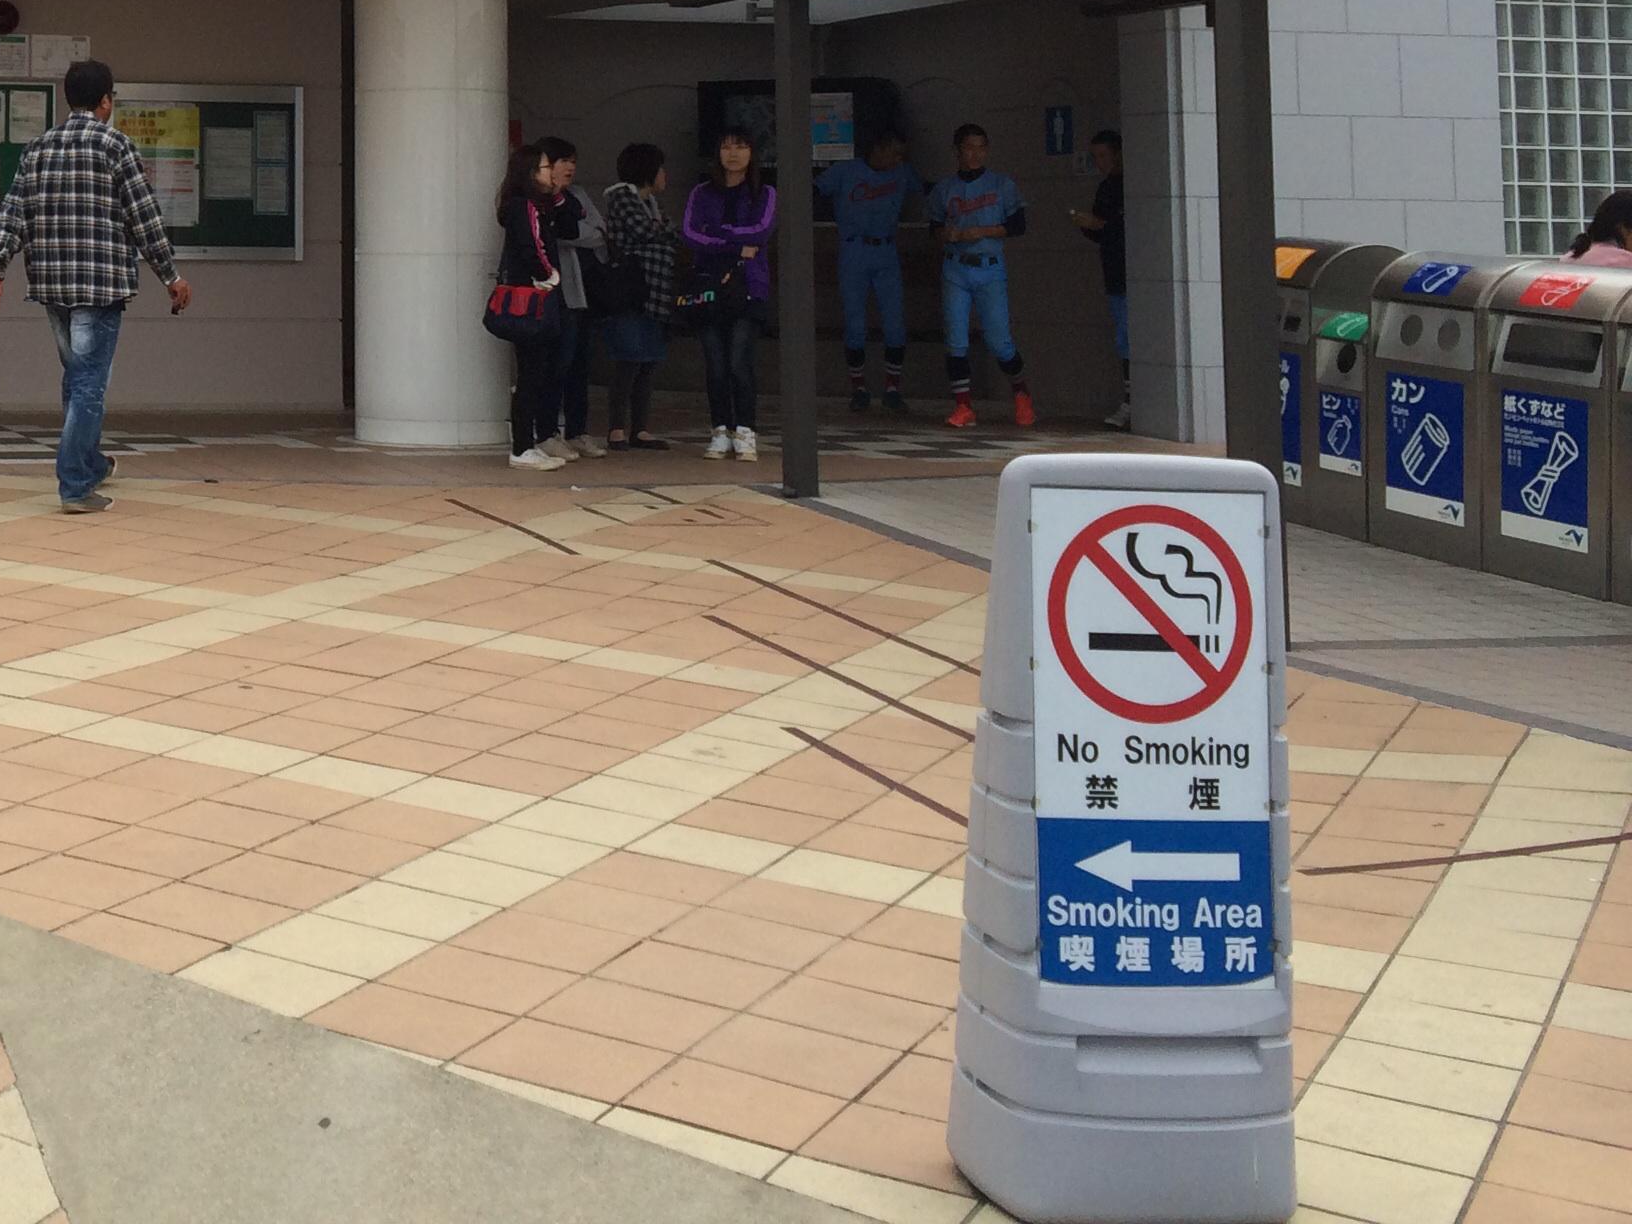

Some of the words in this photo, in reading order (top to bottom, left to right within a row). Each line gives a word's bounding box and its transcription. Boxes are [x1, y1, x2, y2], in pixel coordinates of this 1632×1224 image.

[1391, 378, 1426, 404] カン
[1504, 394, 1566, 420] 紙くずなど
[1057, 733, 1099, 764] No
[1124, 735, 1250, 769] Smoking
[1047, 895, 1179, 931] Smoking
[1193, 897, 1263, 929] Area
[1059, 934, 1257, 973] 喫煙場所
